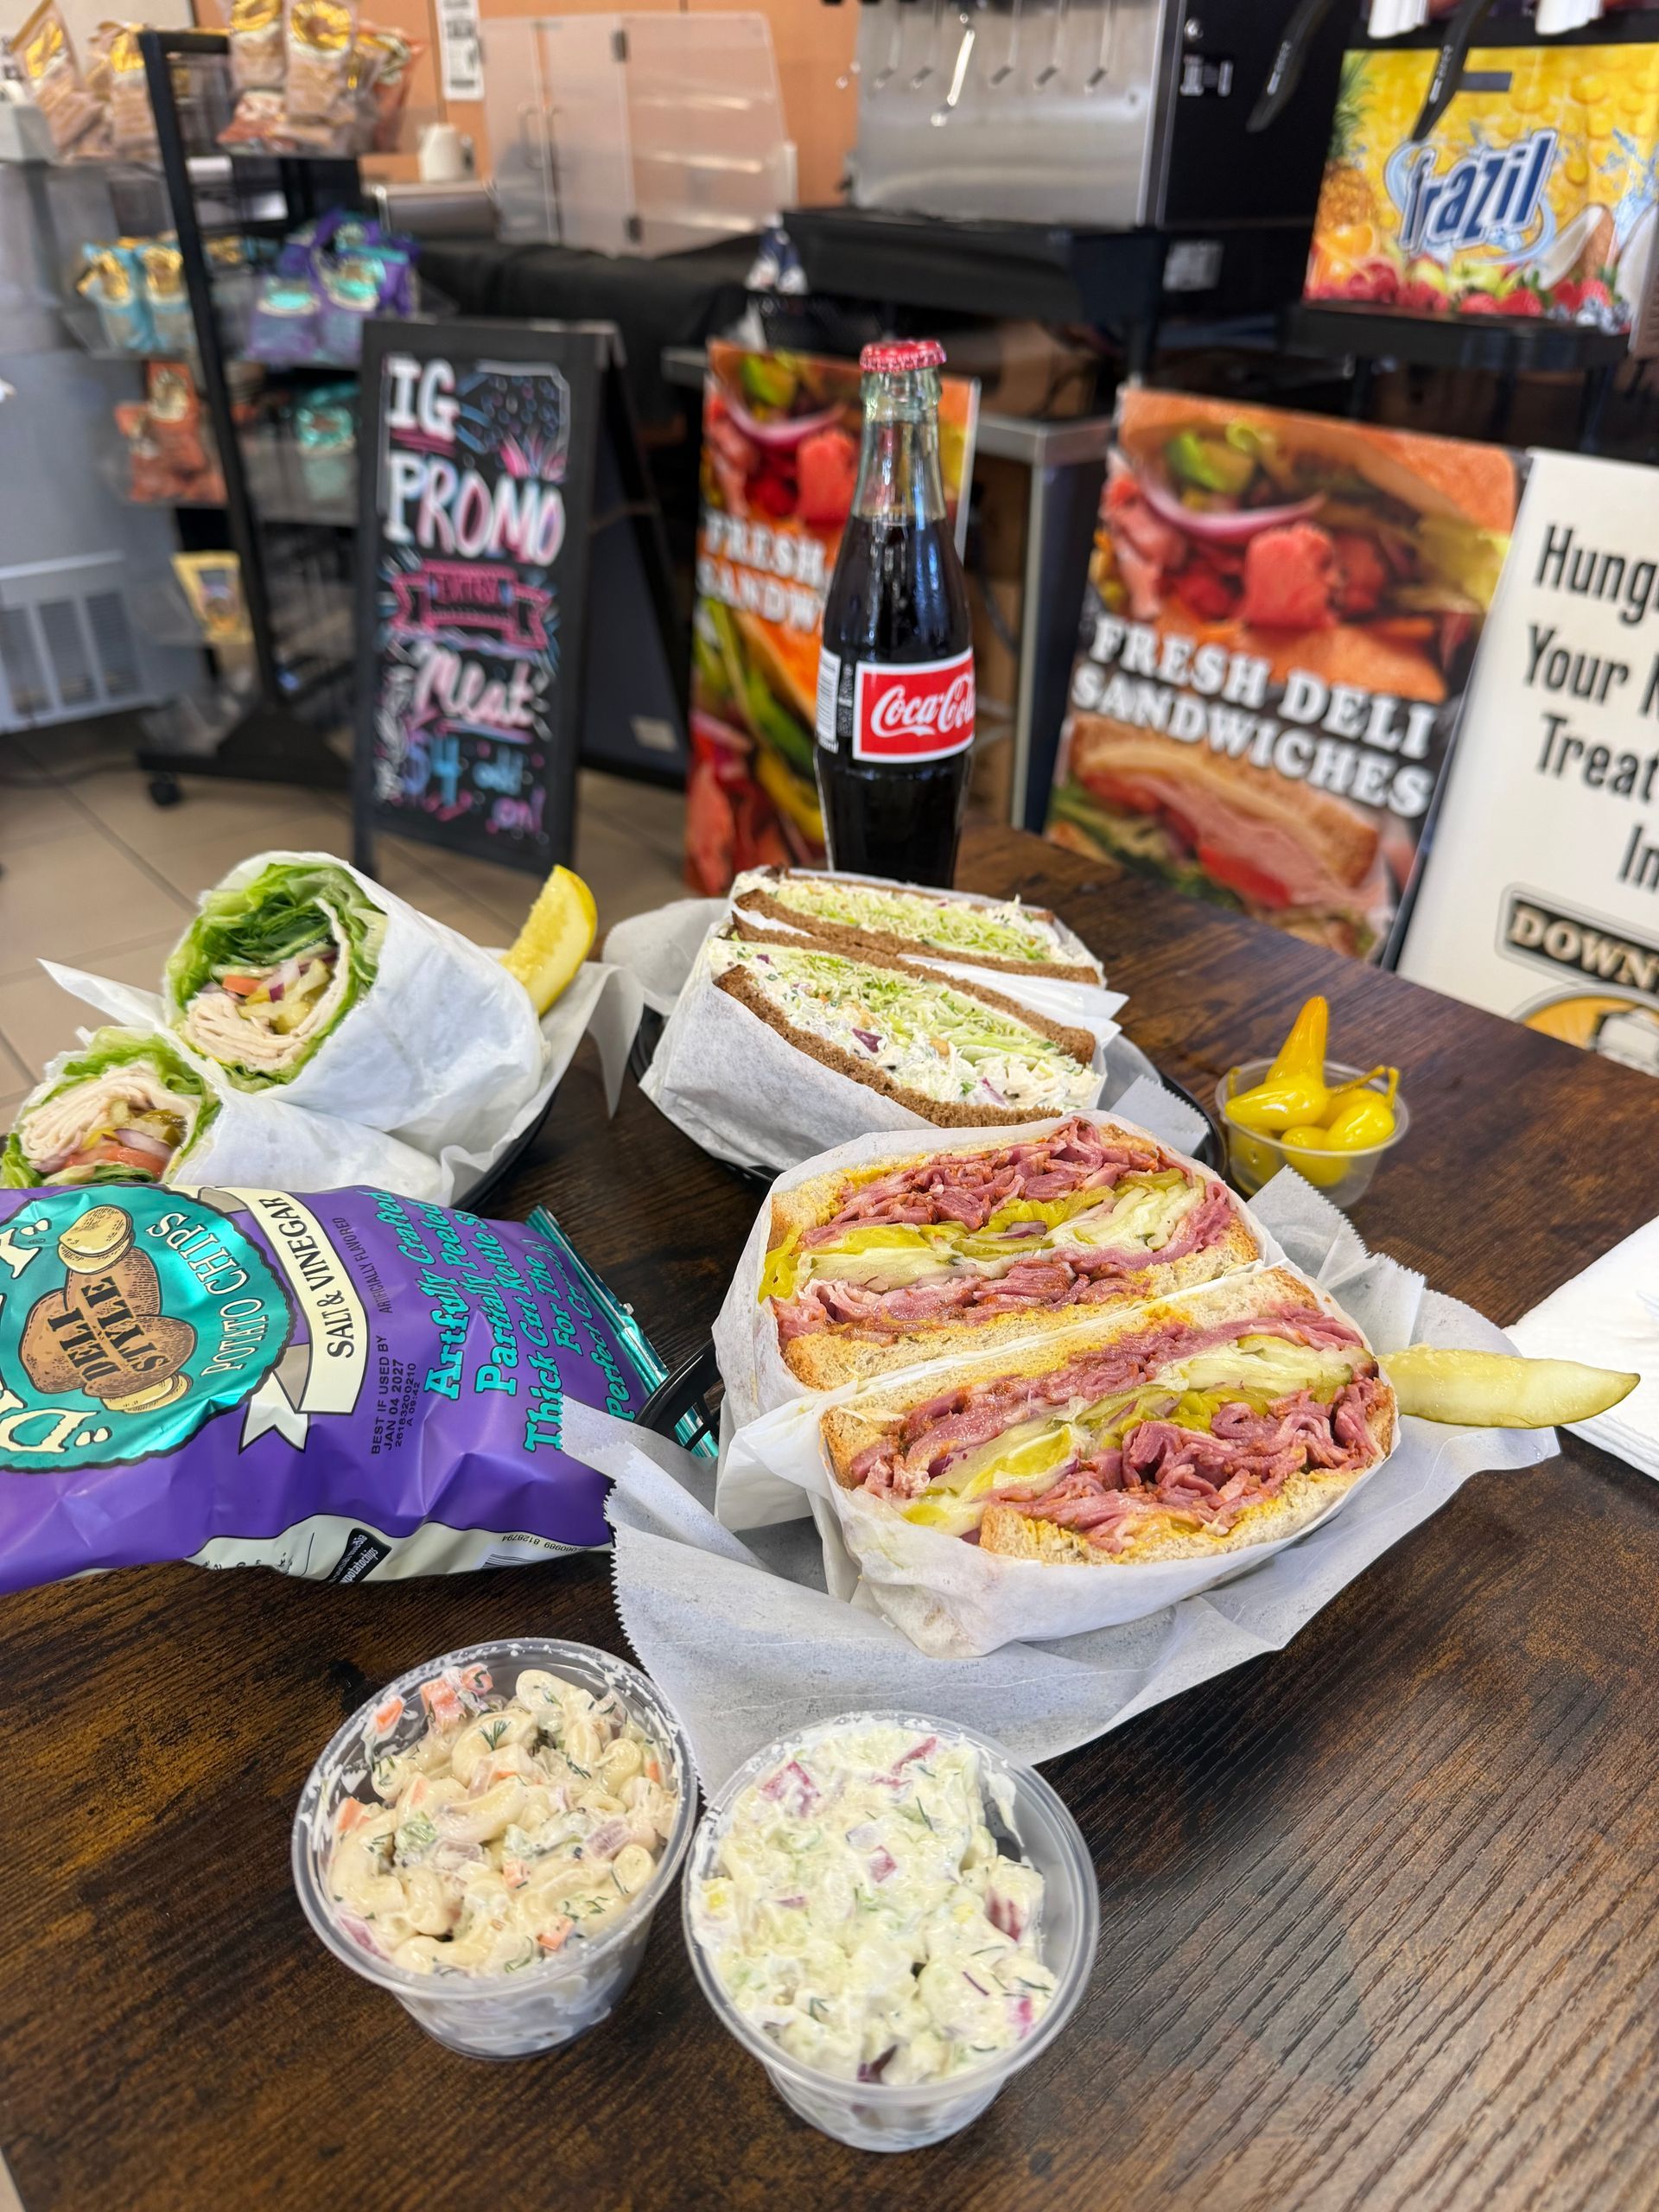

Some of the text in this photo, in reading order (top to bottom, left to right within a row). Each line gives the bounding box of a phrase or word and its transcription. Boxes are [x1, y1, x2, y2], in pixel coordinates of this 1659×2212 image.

[1396, 129, 1557, 252] frazil
[385, 353, 460, 442] IG
[384, 448, 566, 564] PROMO
[695, 557, 821, 633] SANDW
[1090, 613, 1438, 760] FRESH DELI
[1524, 620, 1630, 706] Your
[1071, 662, 1436, 819] SANDWICHES
[1509, 906, 1659, 991] DOWN
[146, 1211, 269, 1376] POTATO CHIPS
[258, 1197, 354, 1358] SALT & VINEGAR
[332, 1217, 393, 1313] ARTIFICIALLY FLAVORED
[355, 1189, 470, 1402] Artfully Crafted
[522, 1253, 584, 1357] For The
[47, 1306, 121, 1382] DELI
[81, 1275, 170, 1375] STYLE
[454, 1272, 519, 1397] Partially
[475, 1234, 564, 1452] Thick Cut Kettle
[588, 1319, 638, 1422] Perfect
[372, 1334, 390, 1454] BEST IF USED BY
[384, 1358, 404, 1451] JAN 04 2027
[406, 1381, 421, 1427] A 09:42
[501, 1533, 541, 1547] 8128794
